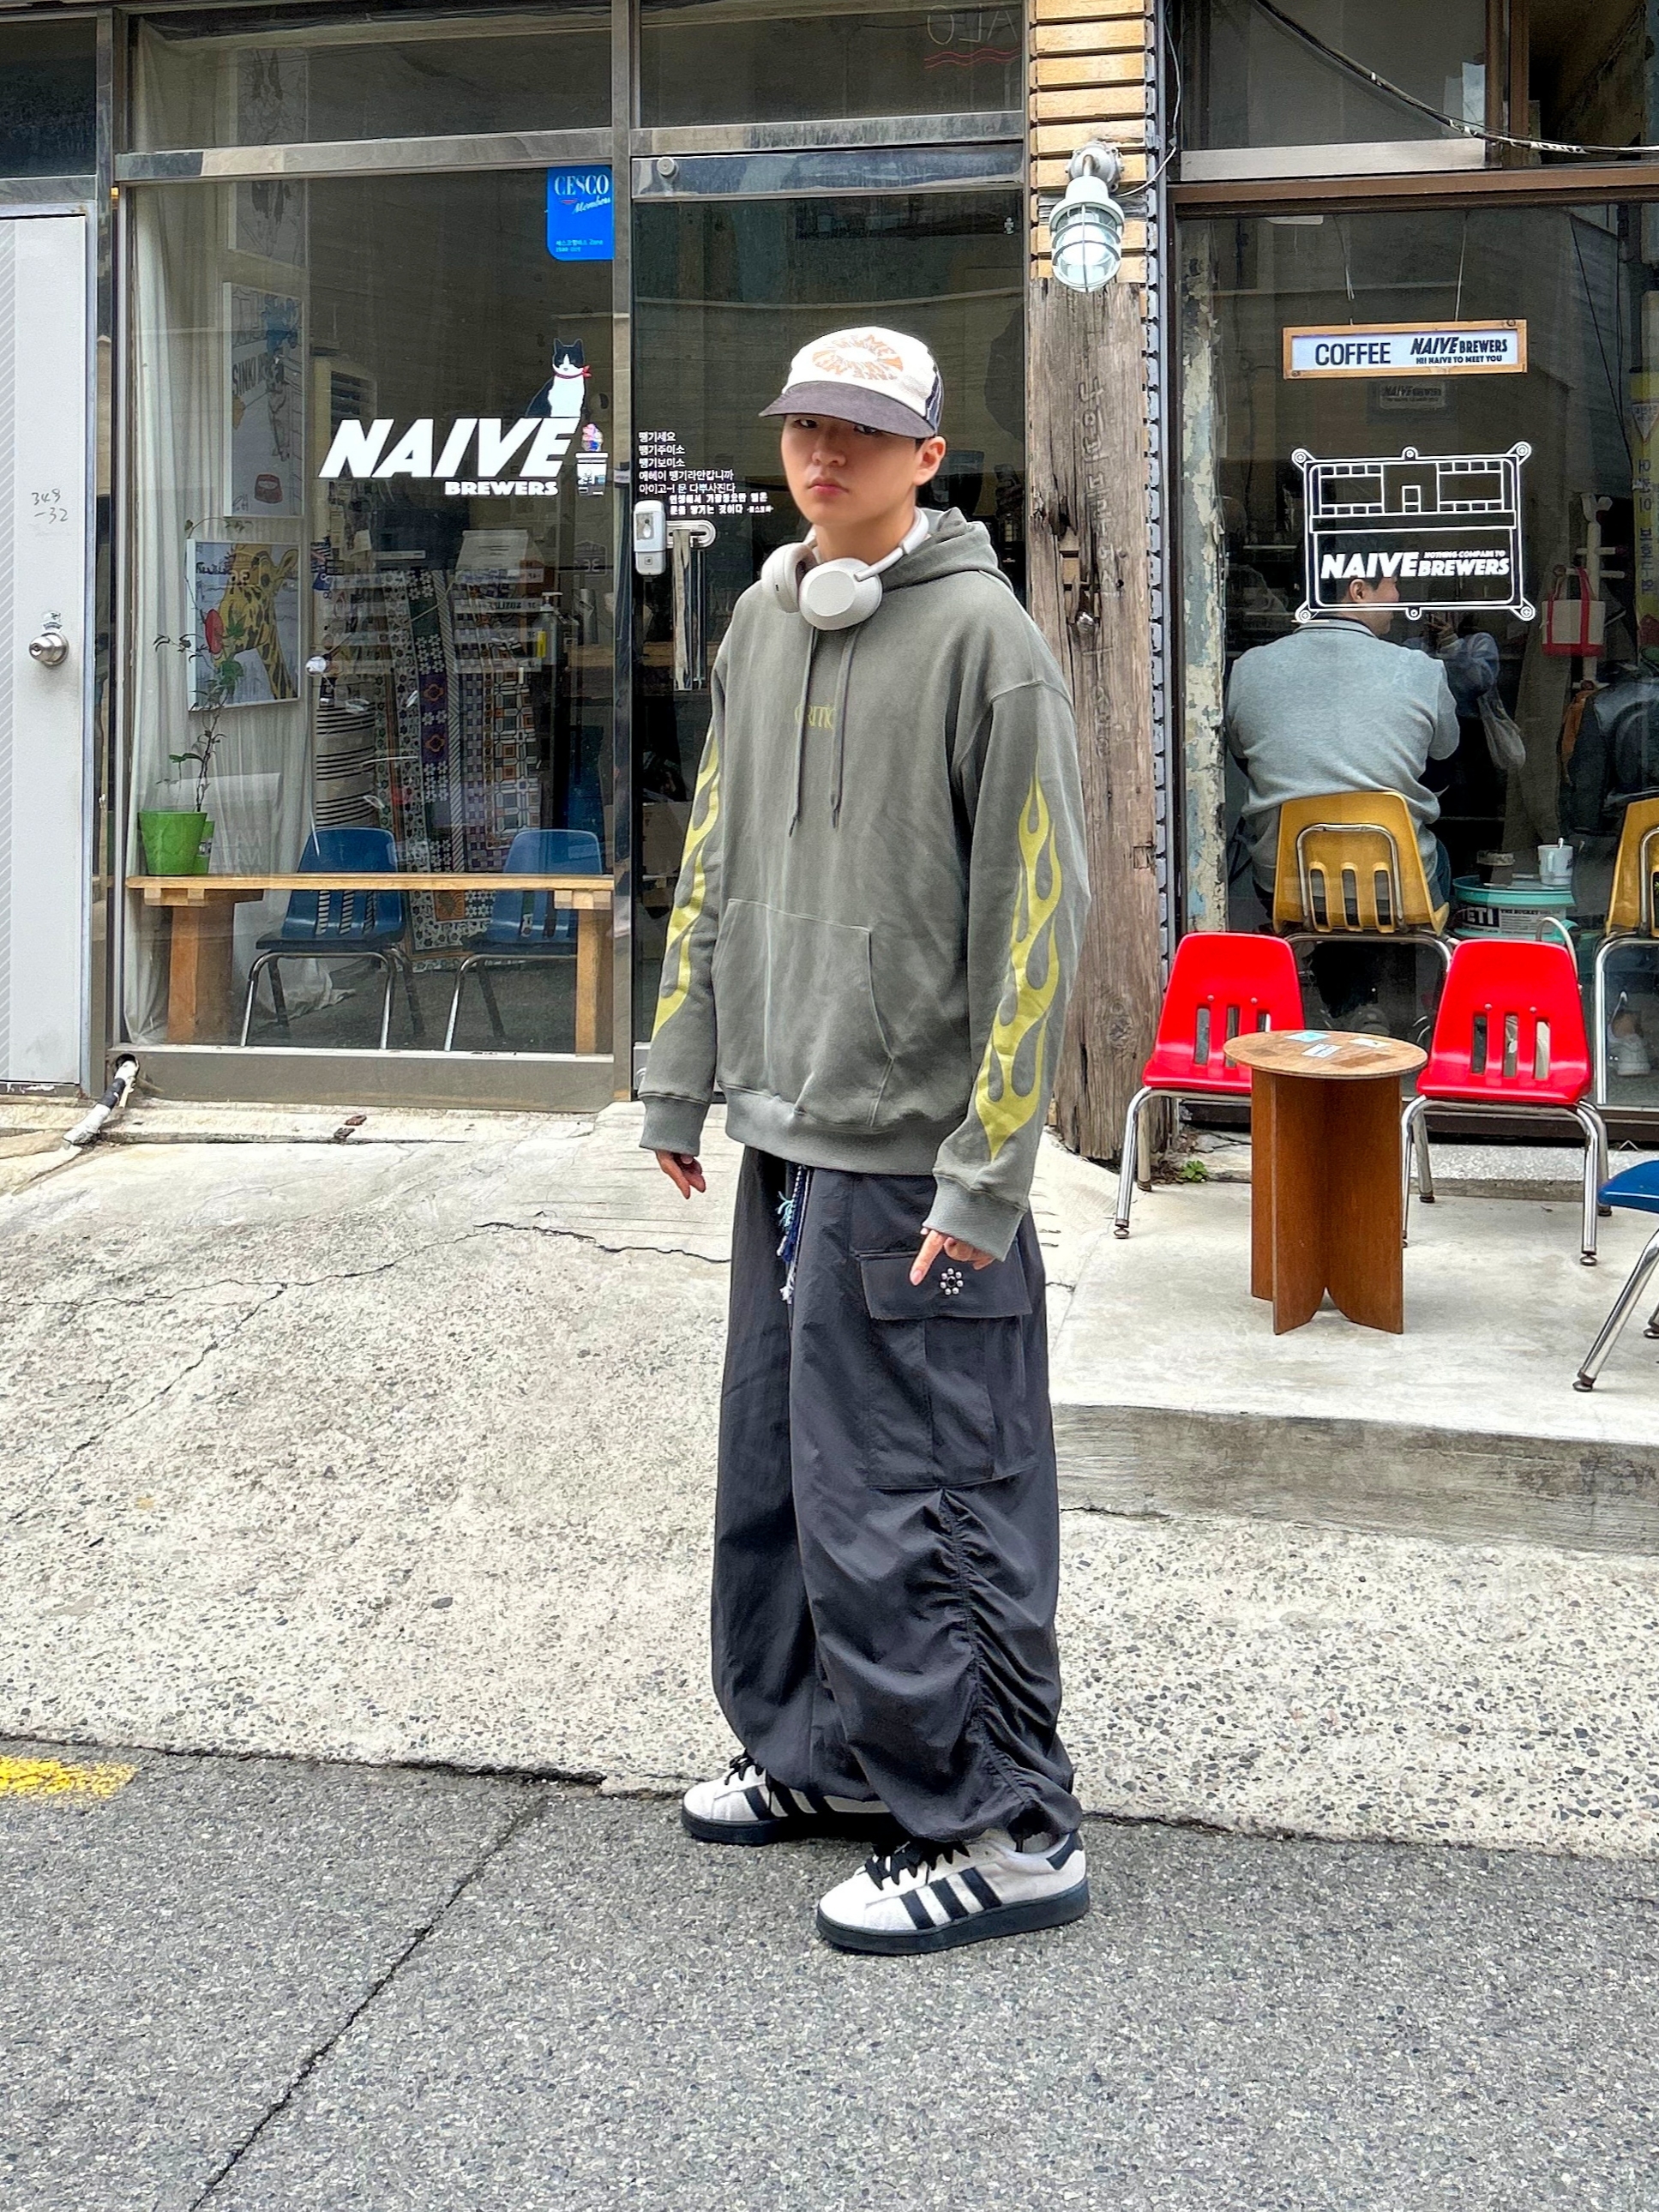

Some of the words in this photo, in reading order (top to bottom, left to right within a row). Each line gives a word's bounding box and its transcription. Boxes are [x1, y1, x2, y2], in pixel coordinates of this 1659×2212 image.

[554, 174, 610, 195] CESCO
[1315, 342, 1391, 365] COFFEE
[1410, 337, 1458, 355] NAIVE
[1458, 339, 1507, 353] BREWERS
[318, 418, 580, 478] NAIVE
[444, 481, 558, 496] BREWERS
[677, 484, 687, 494] 문
[1320, 551, 1419, 579] NAIVE
[1417, 558, 1510, 577] BREWERS
